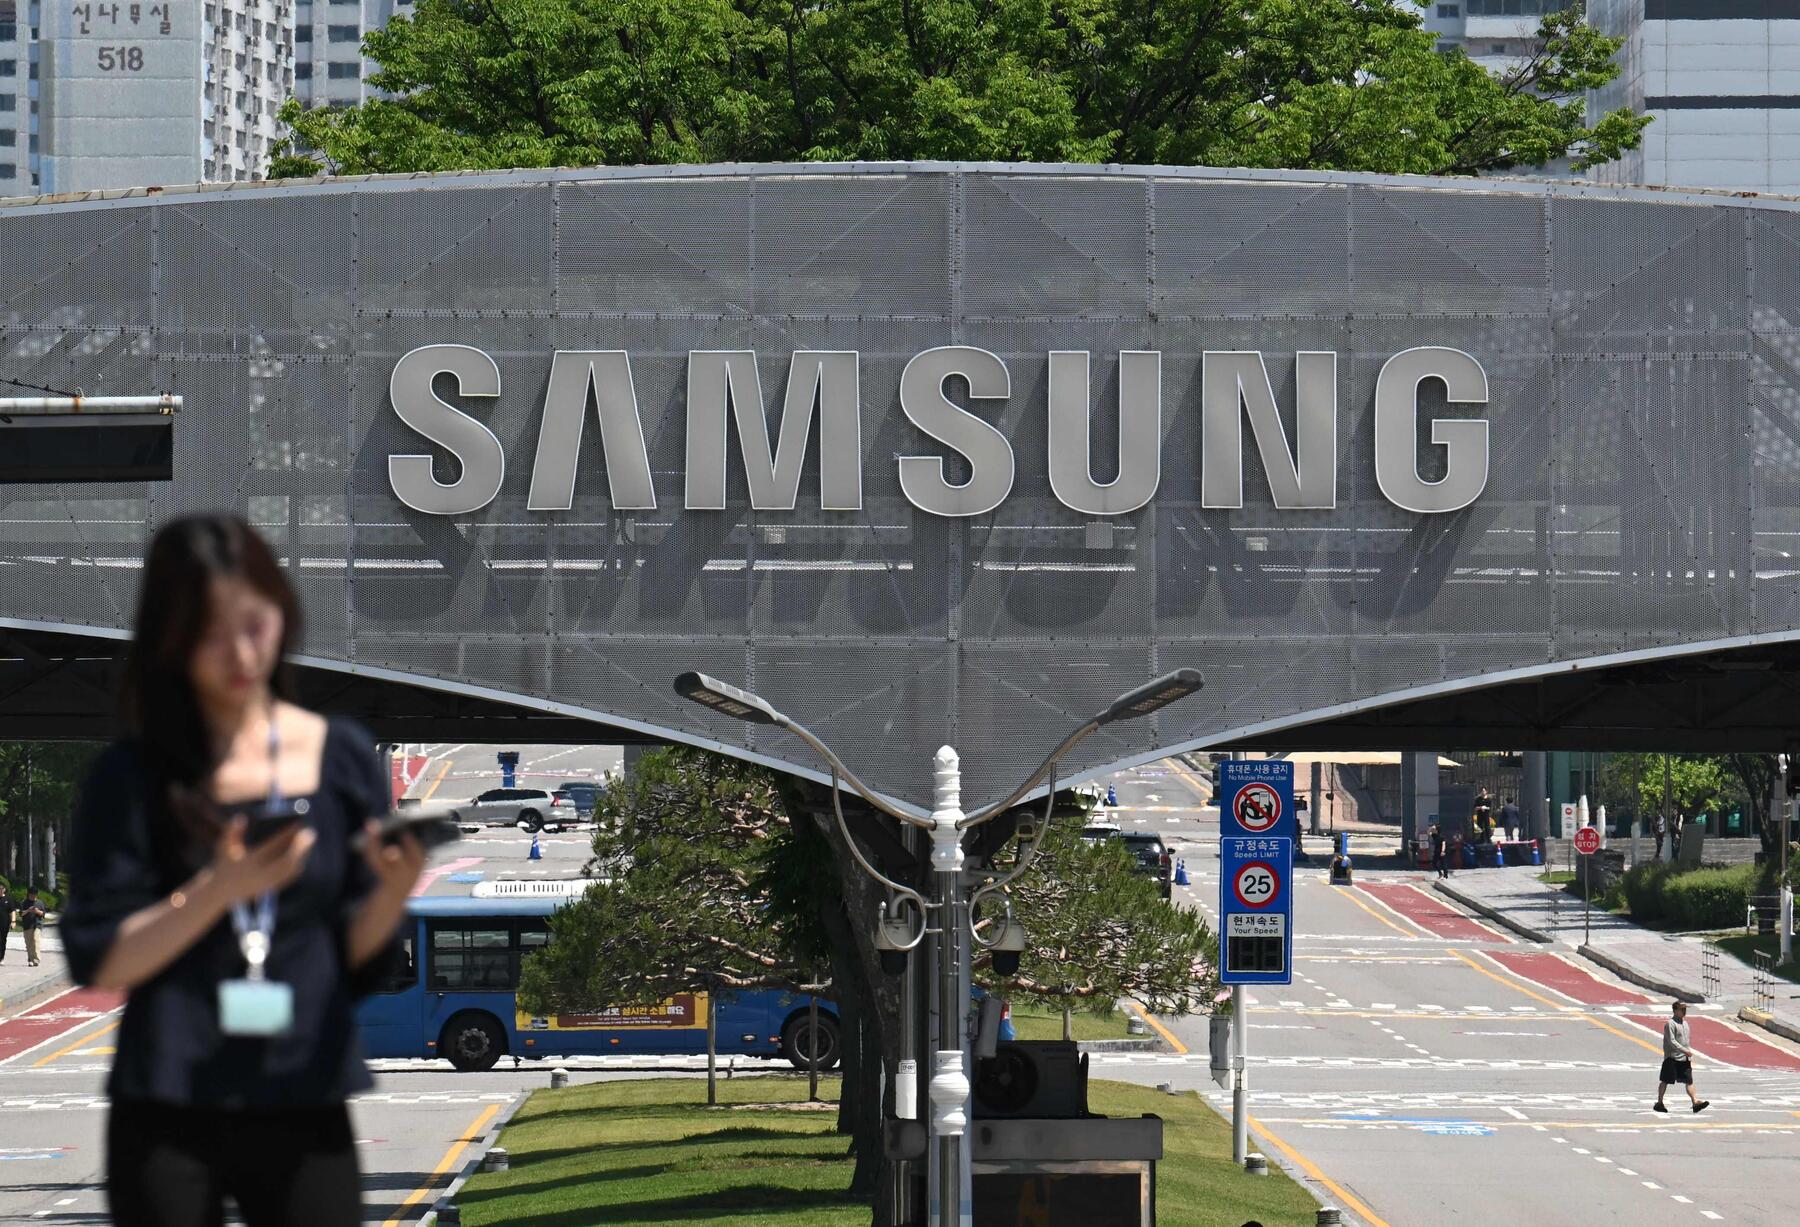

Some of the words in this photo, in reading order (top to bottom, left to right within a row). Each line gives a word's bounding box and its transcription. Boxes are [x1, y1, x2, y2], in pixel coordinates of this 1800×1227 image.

[72, 3, 171, 35] 신나무실
[97, 46, 144, 71] 518
[388, 344, 1489, 518] SAMSUNG
[1228, 764, 1251, 774] 휴대폰
[1254, 764, 1270, 775] 사용
[1272, 764, 1288, 775] 금지
[1234, 840, 1280, 851] 규정속도
[1243, 875, 1271, 895] 25
[1233, 916, 1279, 926] 현재속도
[1253, 927, 1279, 935] Speed
